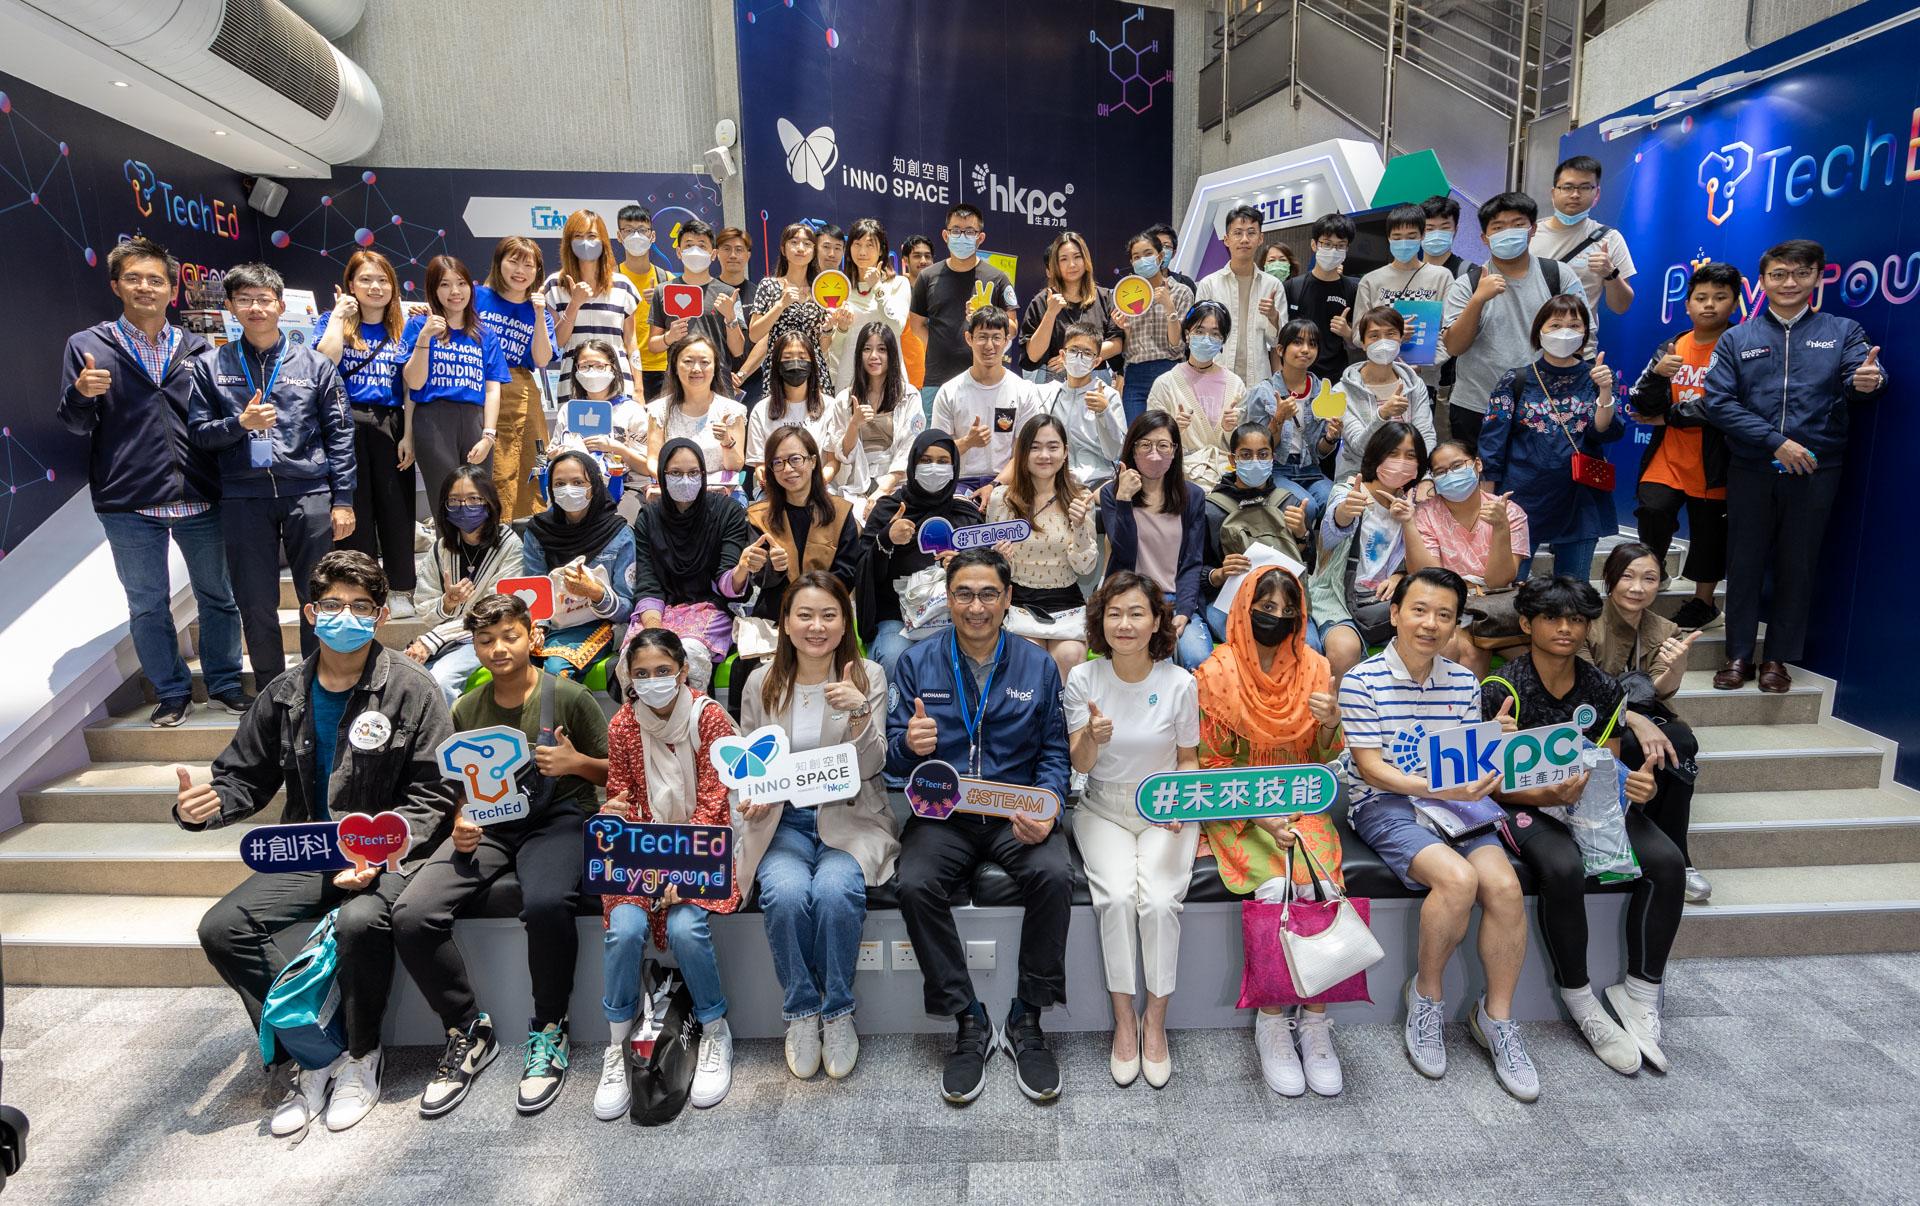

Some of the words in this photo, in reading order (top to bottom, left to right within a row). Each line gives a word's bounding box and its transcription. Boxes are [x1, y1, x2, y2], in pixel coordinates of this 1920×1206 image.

[893, 156, 949, 183] 知創空間
[842, 164, 888, 194] iNNO
[893, 178, 950, 205] SPACE
[157, 180, 240, 240] TechEd
[990, 173, 1067, 225] hkpc
[1034, 216, 1067, 228] 生產力局
[479, 310, 534, 335] EMBRACING
[505, 328, 531, 344] PEOPLE
[433, 350, 456, 362] OUNG
[458, 354, 483, 368] PEOPLE
[454, 378, 483, 392] FAMILY
[958, 524, 1024, 546] #Talent
[795, 753, 849, 772] 知創空間
[1429, 727, 1580, 790] hkpc
[748, 778, 791, 796] iNNO
[796, 766, 850, 787] SPACE
[828, 782, 849, 792] hkpc
[925, 780, 952, 790] TechEd
[966, 788, 1045, 814] #STEAM
[1152, 774, 1322, 815] #未來技能
[468, 801, 522, 822] TechEd
[250, 833, 332, 863] #創科
[358, 833, 401, 847] TechEd
[624, 827, 726, 857] TechEd
[589, 857, 726, 894] Playground
